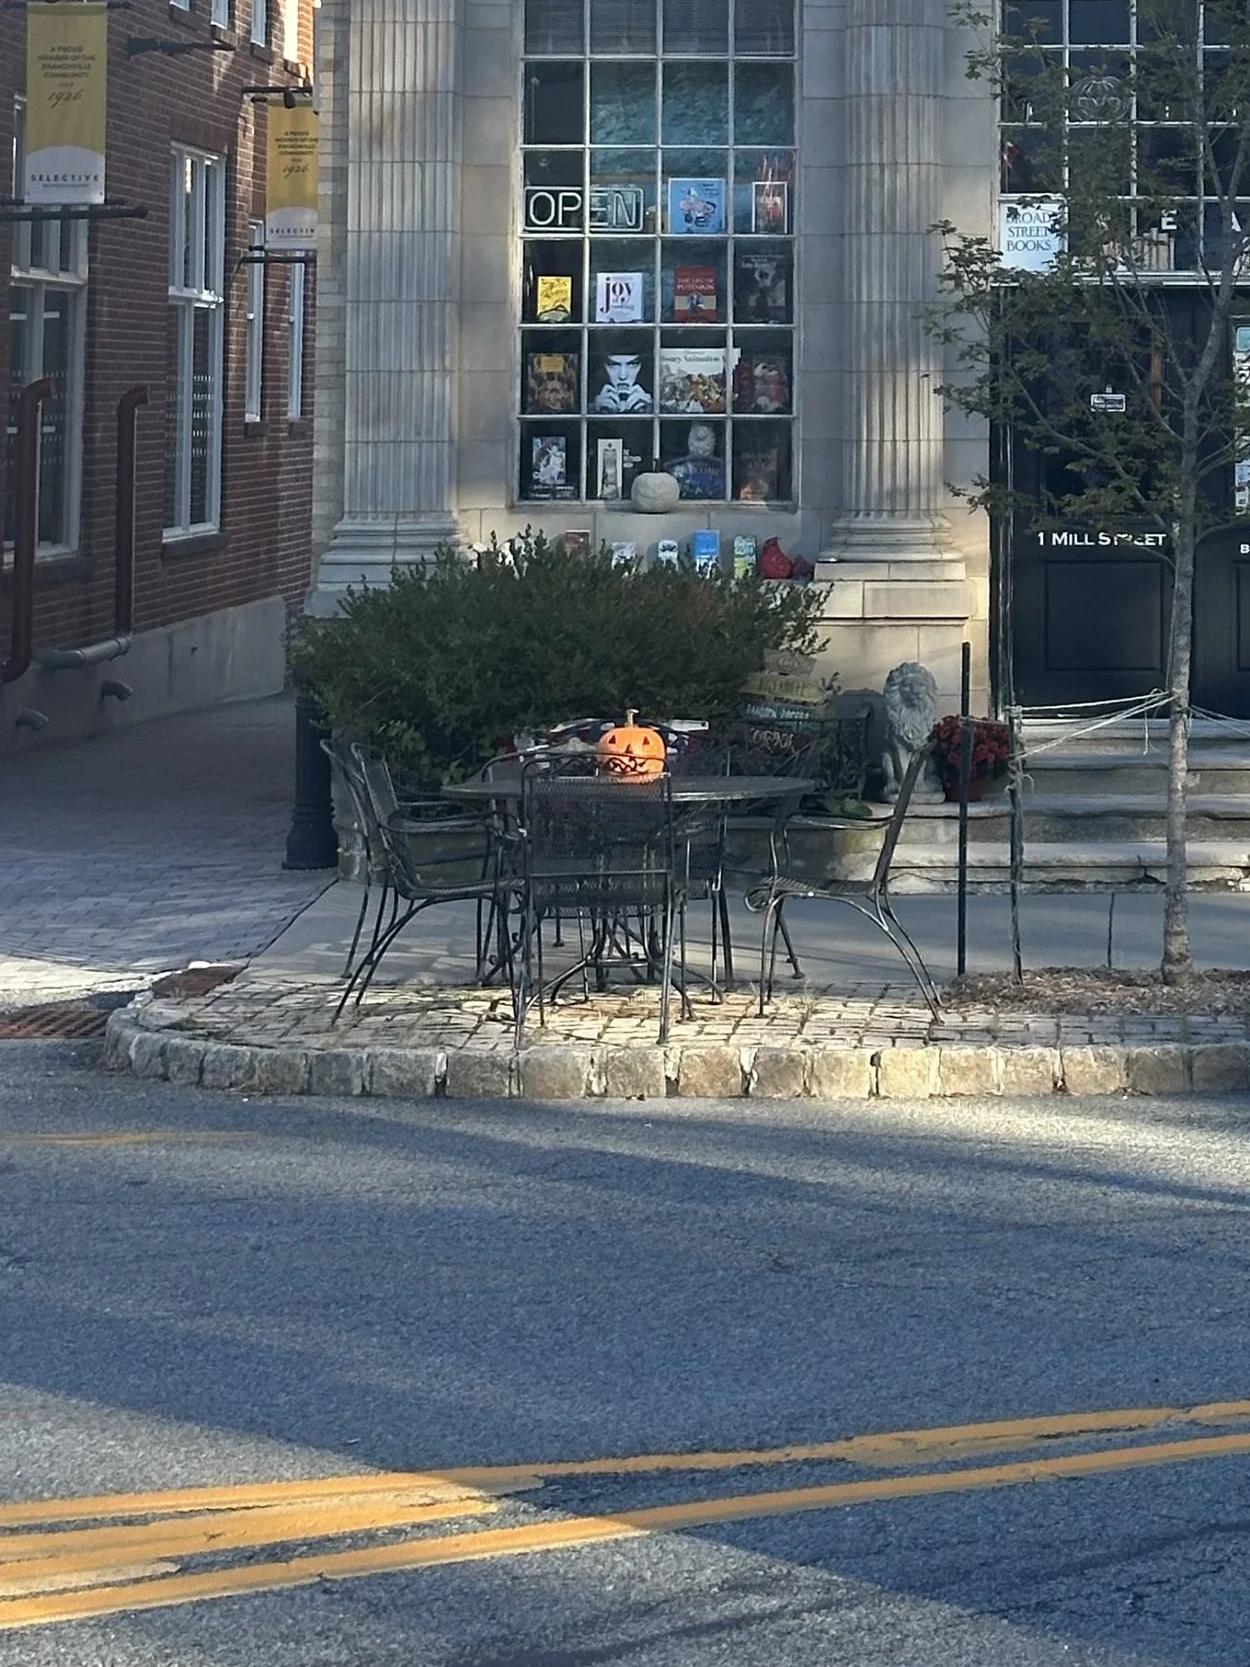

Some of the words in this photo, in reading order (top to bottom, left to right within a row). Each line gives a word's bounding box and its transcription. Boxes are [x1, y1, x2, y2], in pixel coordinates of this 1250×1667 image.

[47, 89, 84, 109] 1926
[30, 173, 100, 183] SELECTIVE
[529, 191, 637, 227] OPEN
[1008, 226, 1049, 238] STREET
[1006, 239, 1052, 252] BOOKS
[1038, 532, 1044, 545] 1
[1052, 532, 1096, 545] MILL
